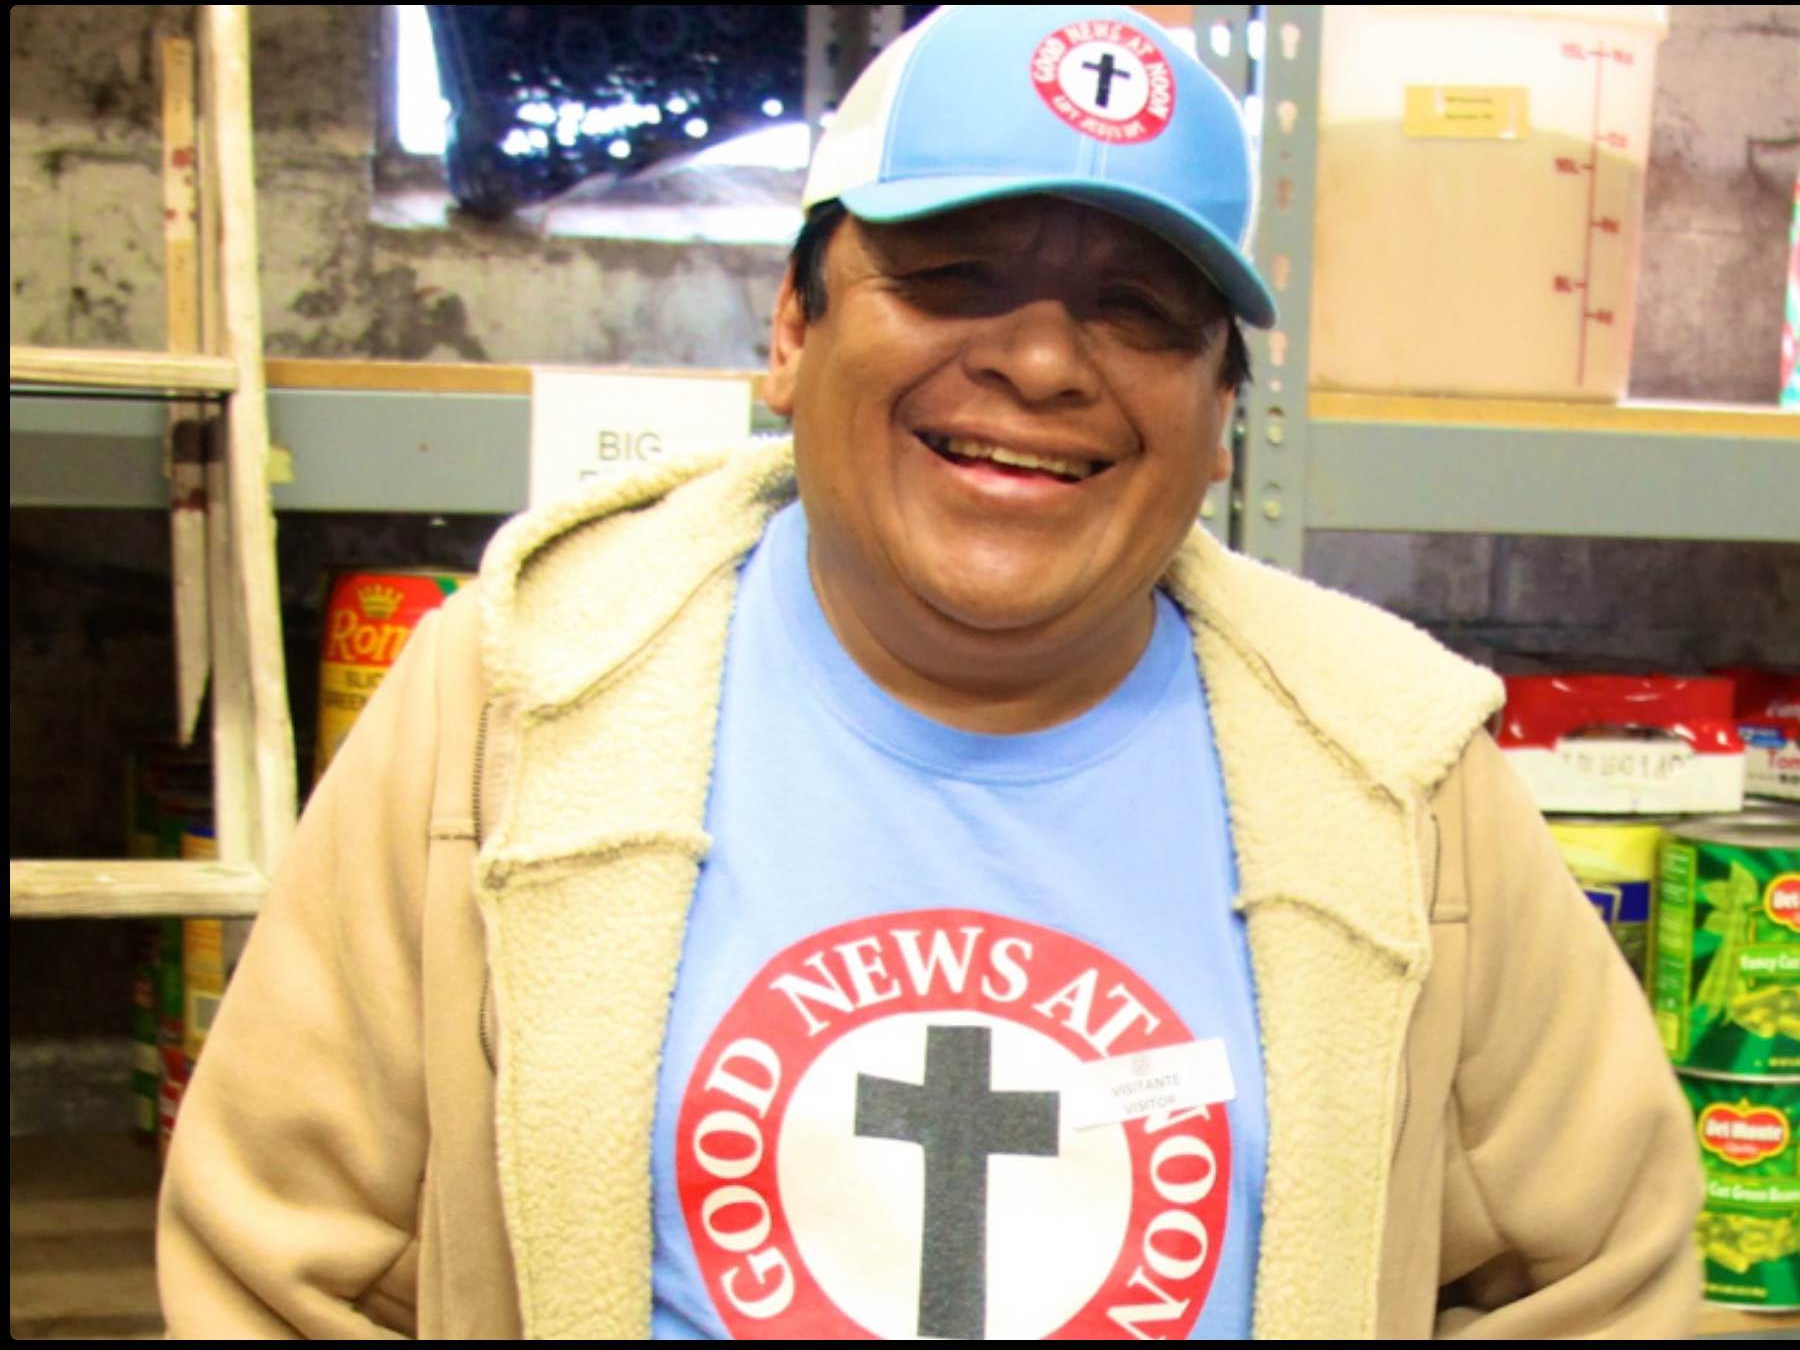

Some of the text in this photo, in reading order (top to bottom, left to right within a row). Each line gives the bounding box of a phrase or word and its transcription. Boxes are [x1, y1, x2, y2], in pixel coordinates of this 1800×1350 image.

[598, 430, 663, 461] BIG
[692, 1037, 796, 1320] GOOD
[769, 925, 1034, 1038] NEWS
[1032, 966, 1161, 1058] AT
